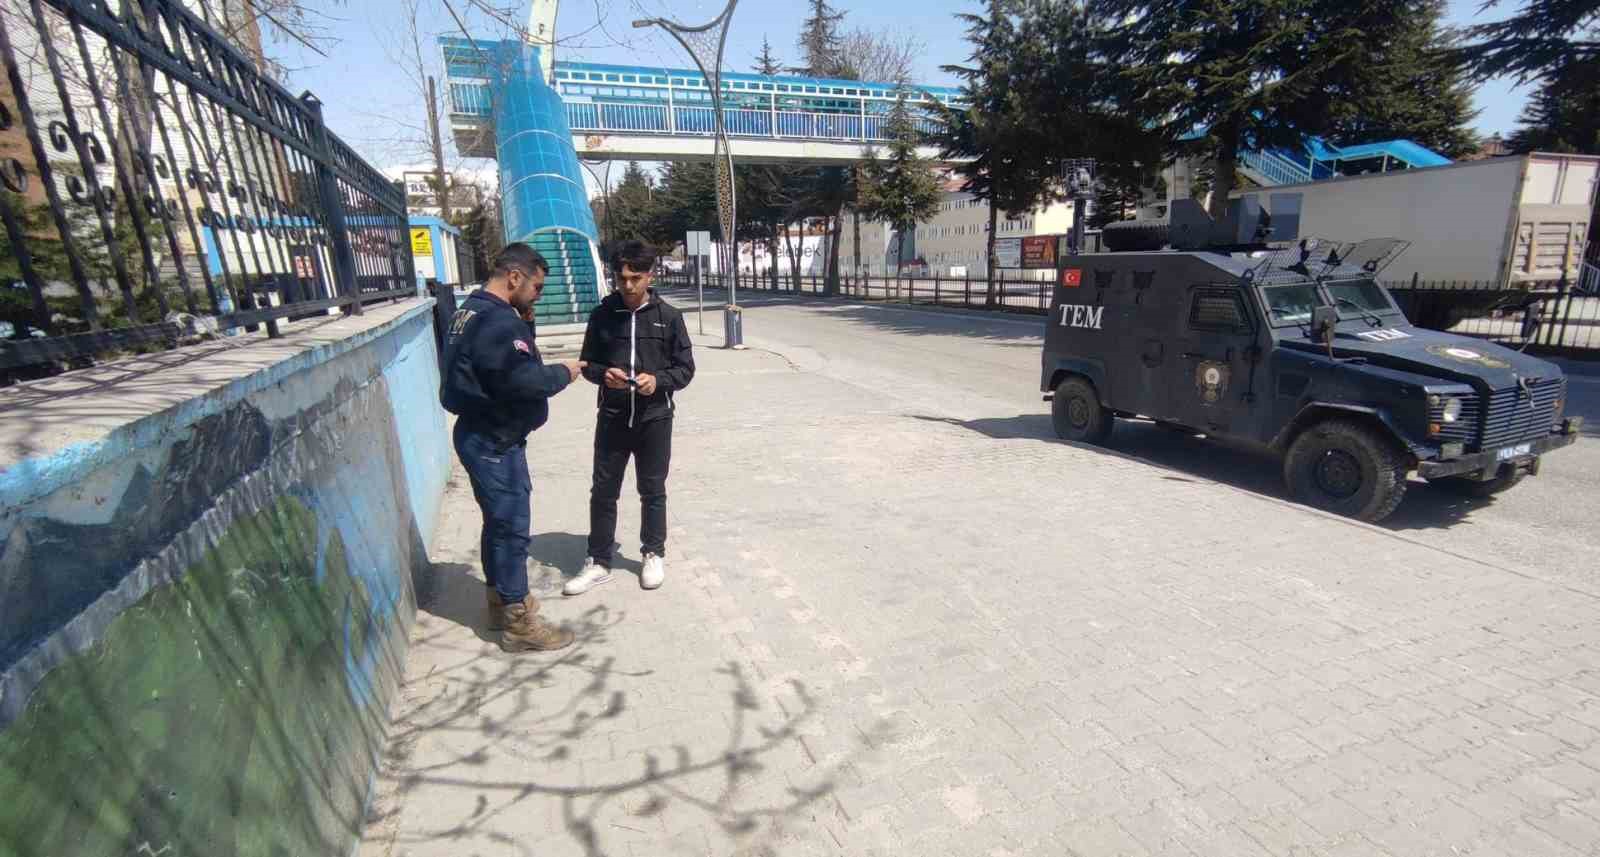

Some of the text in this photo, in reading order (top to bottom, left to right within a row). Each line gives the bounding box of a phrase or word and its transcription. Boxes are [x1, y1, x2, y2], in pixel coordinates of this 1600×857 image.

[764, 244, 822, 258] elebek
[1059, 303, 1105, 329] TEM
[1357, 328, 1414, 341] TEM
